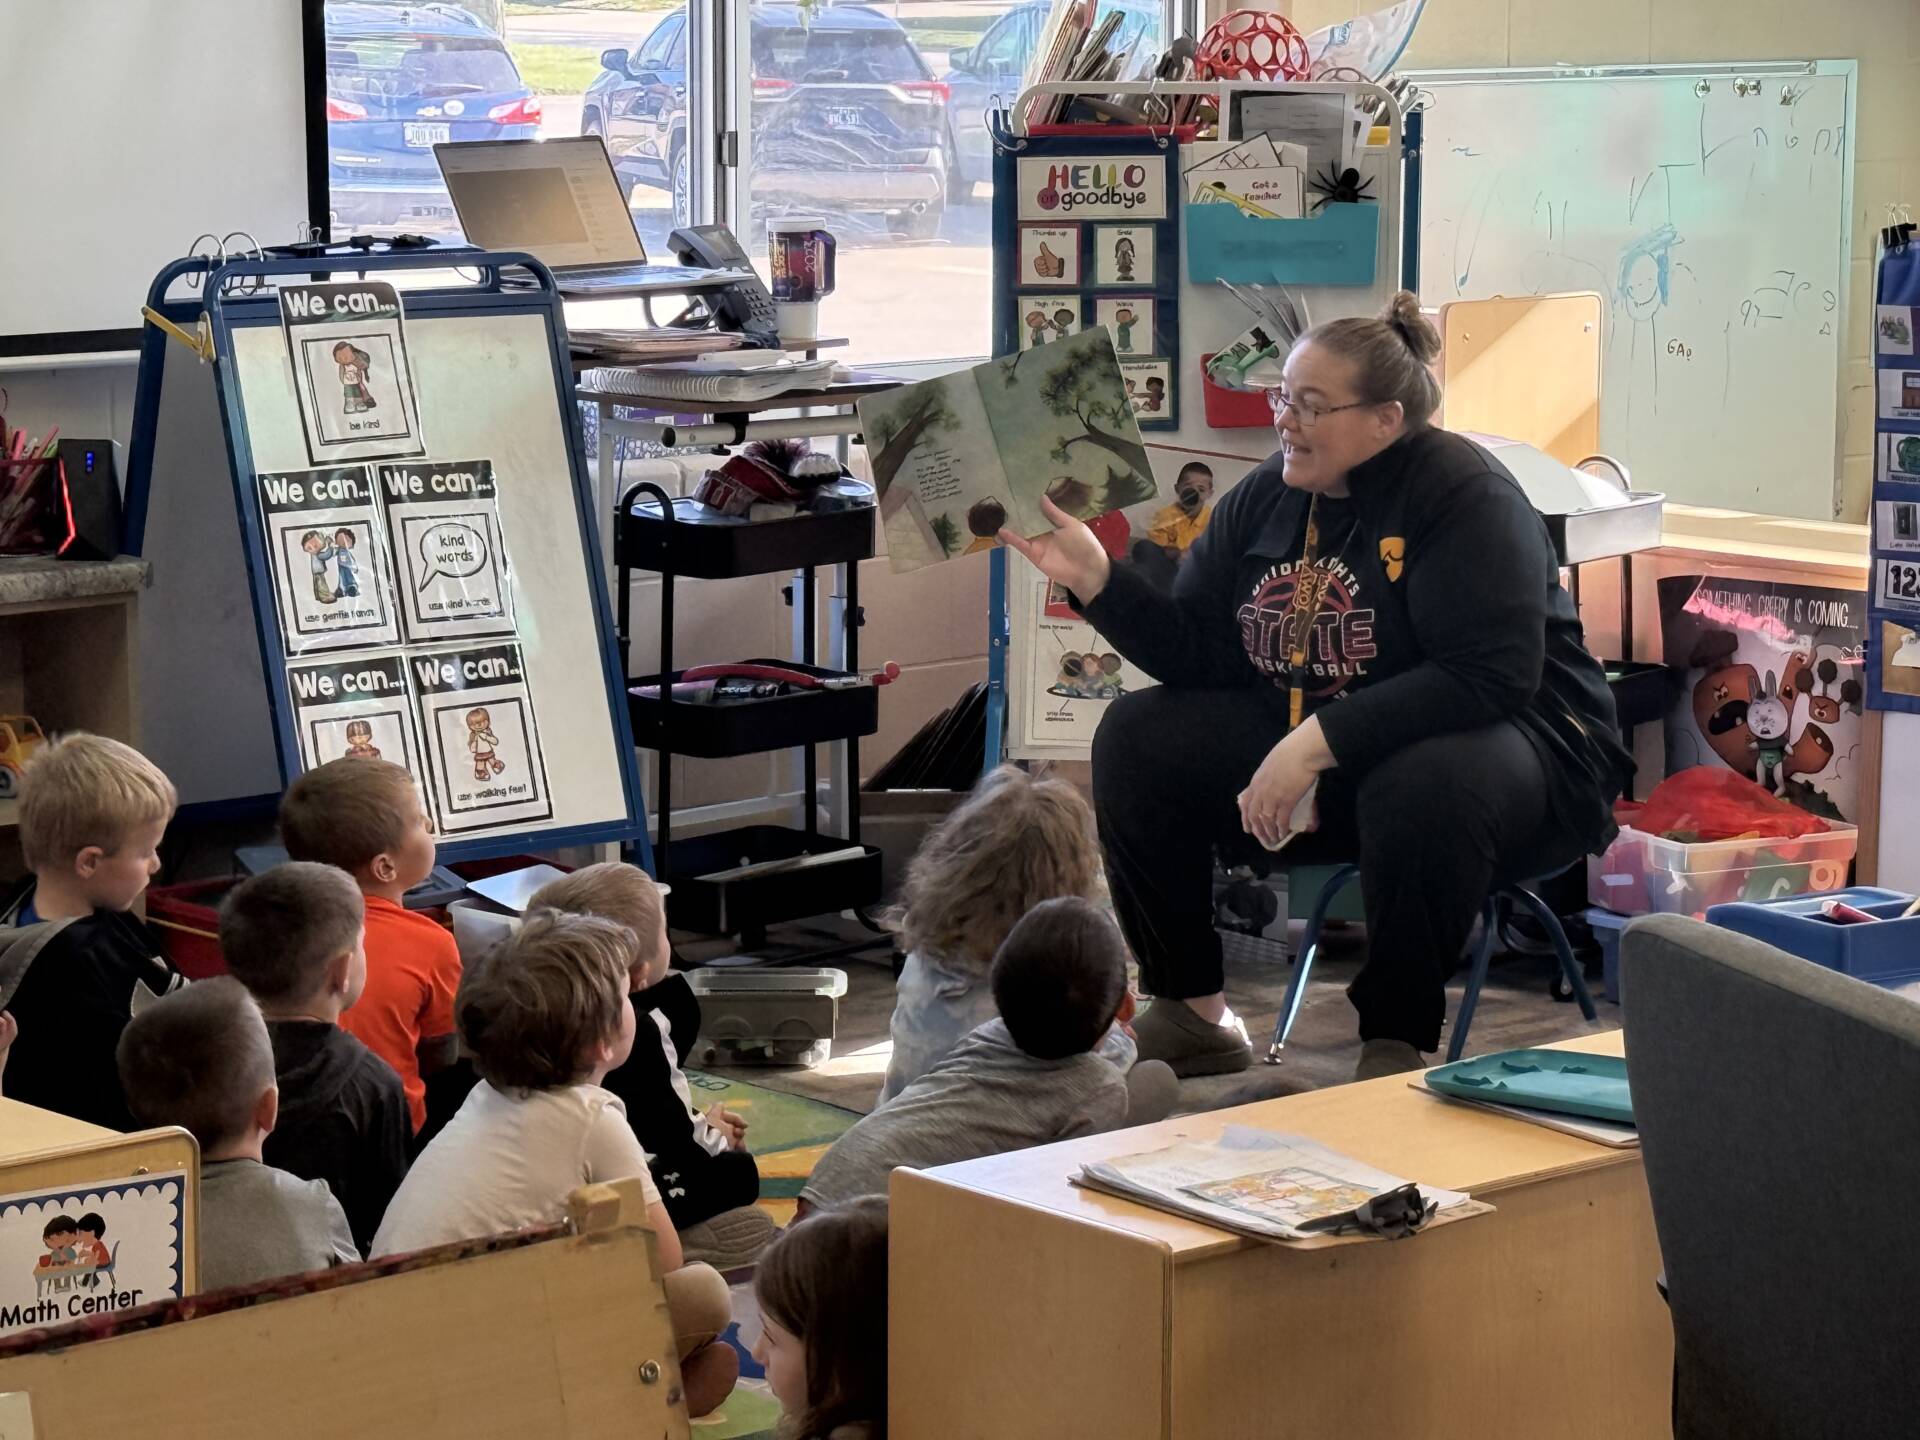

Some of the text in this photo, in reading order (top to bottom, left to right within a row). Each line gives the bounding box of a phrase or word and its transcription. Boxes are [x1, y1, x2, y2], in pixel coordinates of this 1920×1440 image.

[1048, 164, 1146, 190] HELLO
[1061, 186, 1146, 211] goodbye
[804, 241, 816, 272] 2023
[285, 290, 396, 317] We can...
[264, 478, 304, 504] We
[384, 470, 424, 496] We
[439, 533, 466, 548] kind
[436, 549, 475, 564] words
[465, 597, 491, 608] wds
[1696, 588, 1751, 613] SOMETHING
[1758, 595, 1789, 622] CREEPY
[1794, 598, 1803, 624] IS
[1237, 604, 1378, 661] STATE
[416, 658, 456, 687] We
[1248, 653, 1368, 678] ASKBALL
[293, 671, 334, 699] We
[475, 787, 507, 799] walking
[0, 1289, 143, 1329] Math Center
